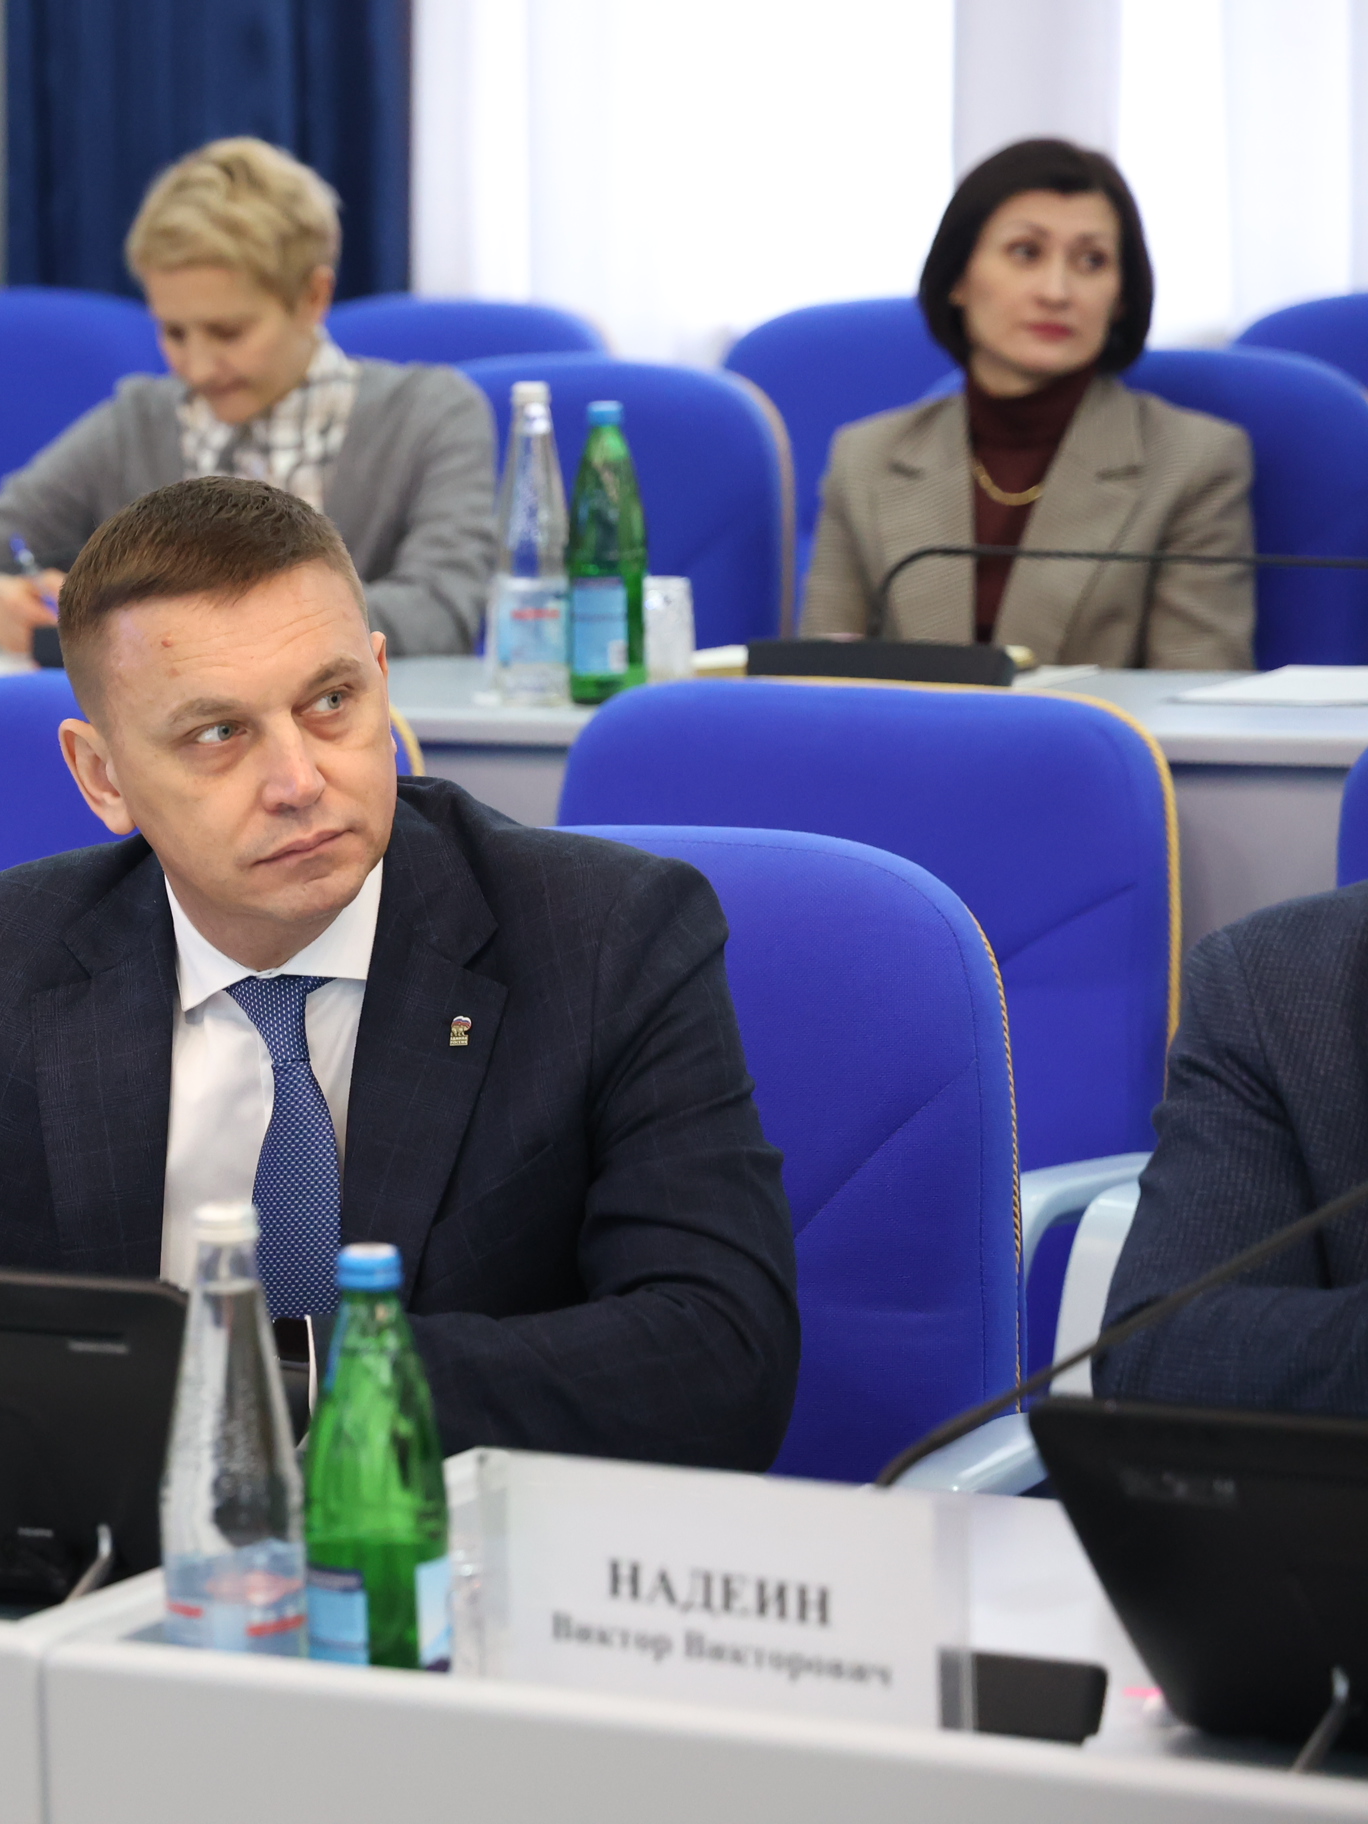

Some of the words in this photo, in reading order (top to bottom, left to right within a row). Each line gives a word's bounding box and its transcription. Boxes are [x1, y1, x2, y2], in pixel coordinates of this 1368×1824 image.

[607, 1556, 832, 1629] НАДЕИН
[550, 1610, 674, 1664] Виктор
[683, 1629, 894, 1688] Викторович
